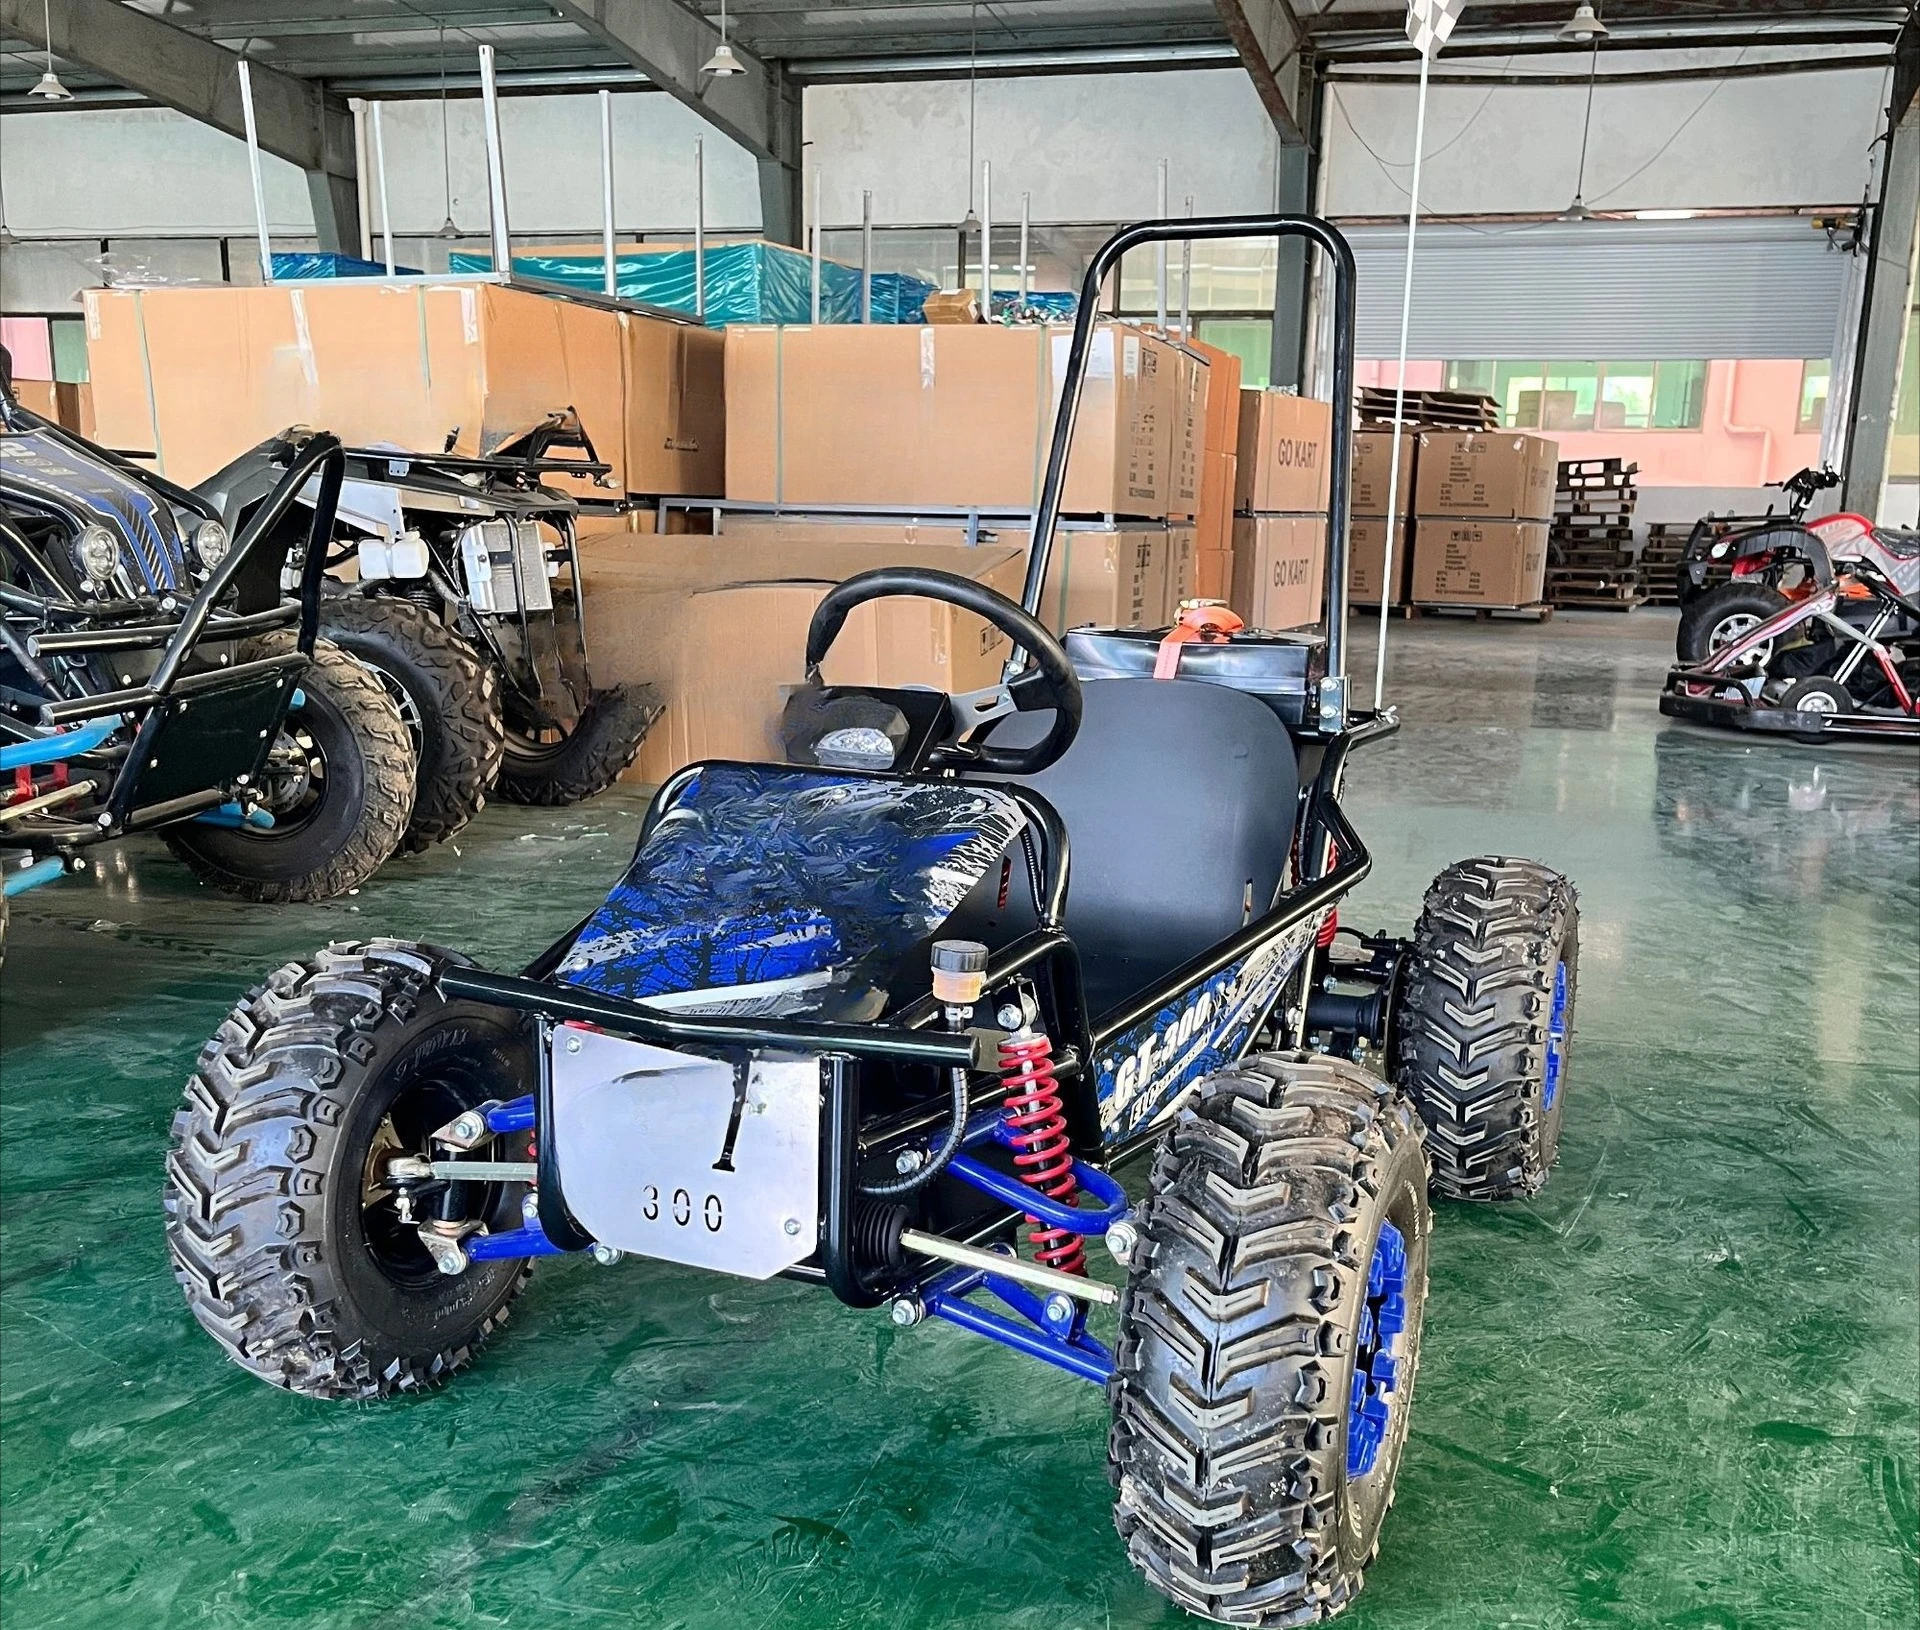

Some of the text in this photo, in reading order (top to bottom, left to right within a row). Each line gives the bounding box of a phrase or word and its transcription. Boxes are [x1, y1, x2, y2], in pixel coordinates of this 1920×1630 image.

[1278, 438, 1318, 468] GO KART
[1273, 558, 1309, 588] GO KART
[643, 1184, 722, 1232] 300
